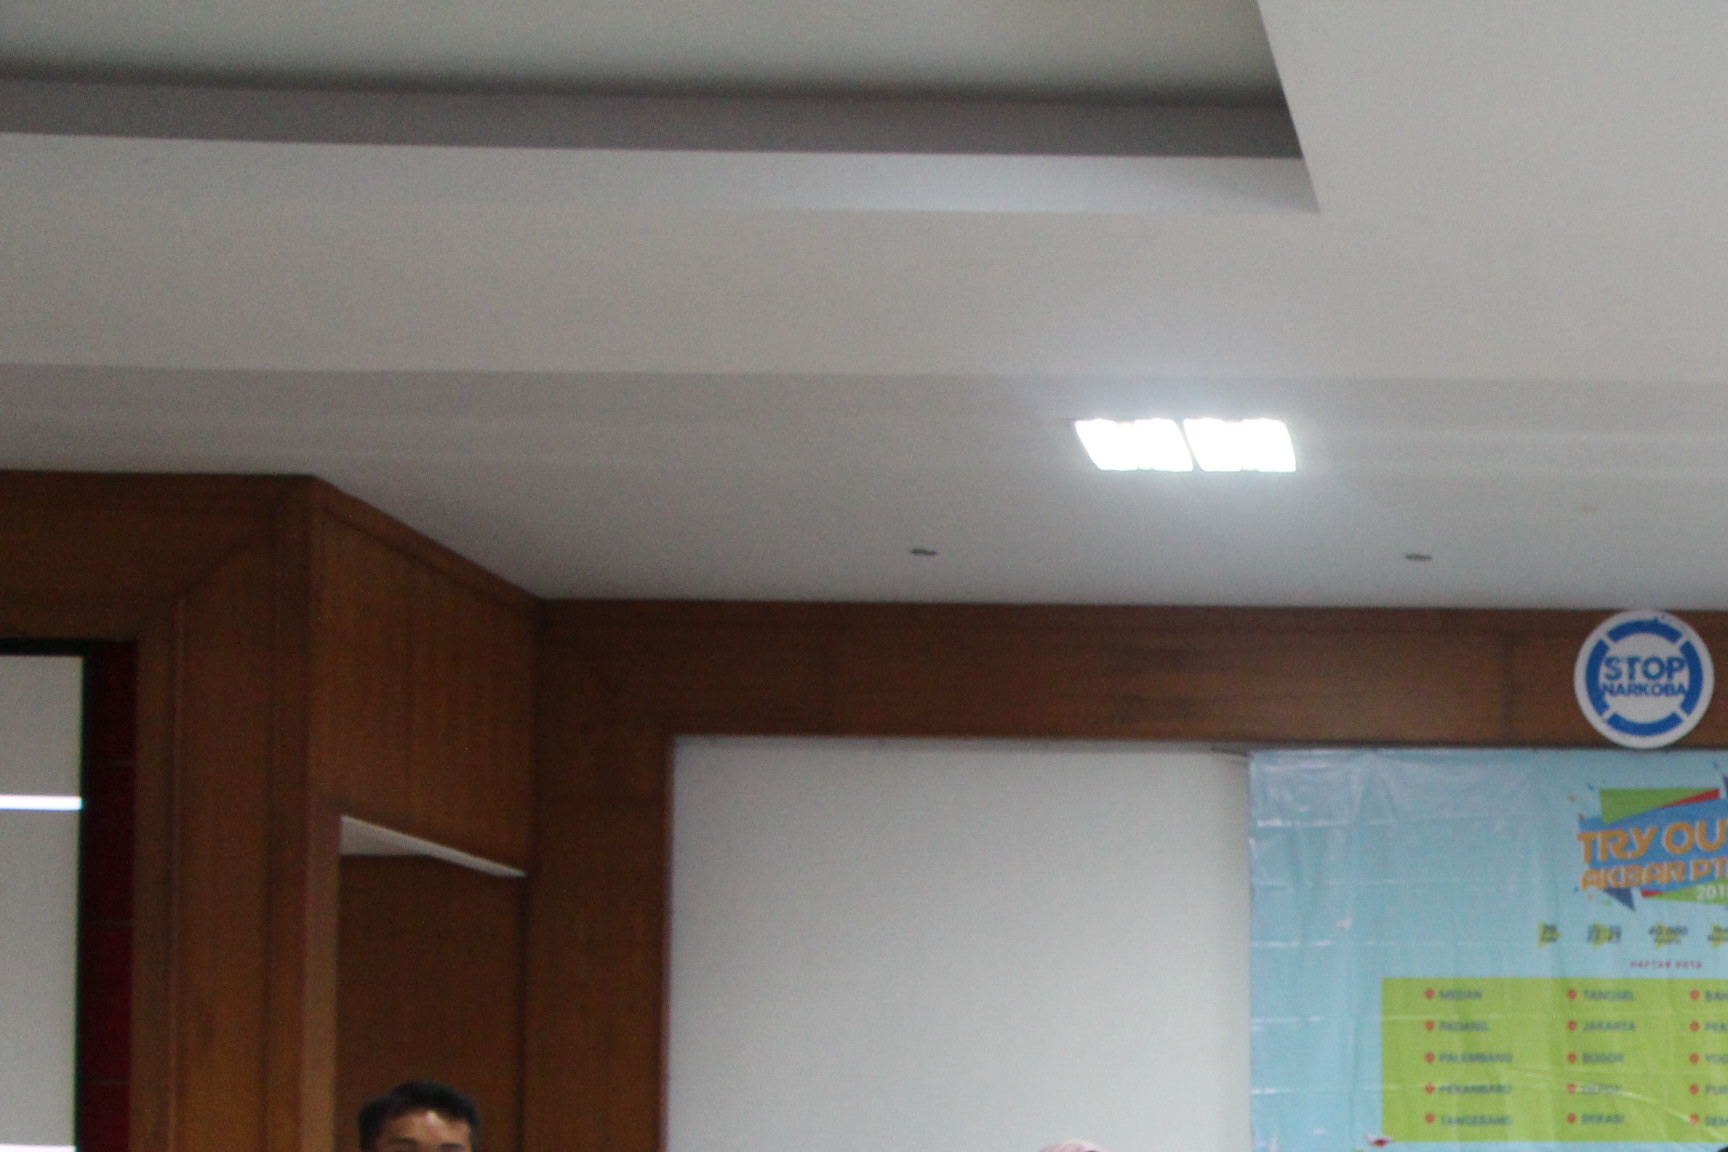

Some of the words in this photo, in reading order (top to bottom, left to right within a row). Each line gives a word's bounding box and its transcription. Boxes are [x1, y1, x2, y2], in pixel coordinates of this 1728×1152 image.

[1603, 656, 1686, 681] STOP
[1601, 682, 1688, 696] NARKOBA
[1577, 825, 1659, 864] TRY
[1580, 861, 1686, 891] AKBAR
[1439, 990, 1483, 1000] MEDAN
[1439, 1021, 1489, 1032] PADANG
[1583, 1021, 1636, 1032] JAKARTA
[1439, 1053, 1513, 1064] PALEMBANG
[1582, 1053, 1624, 1063] BOGOR
[1440, 1115, 1513, 1126] TANGERANG
